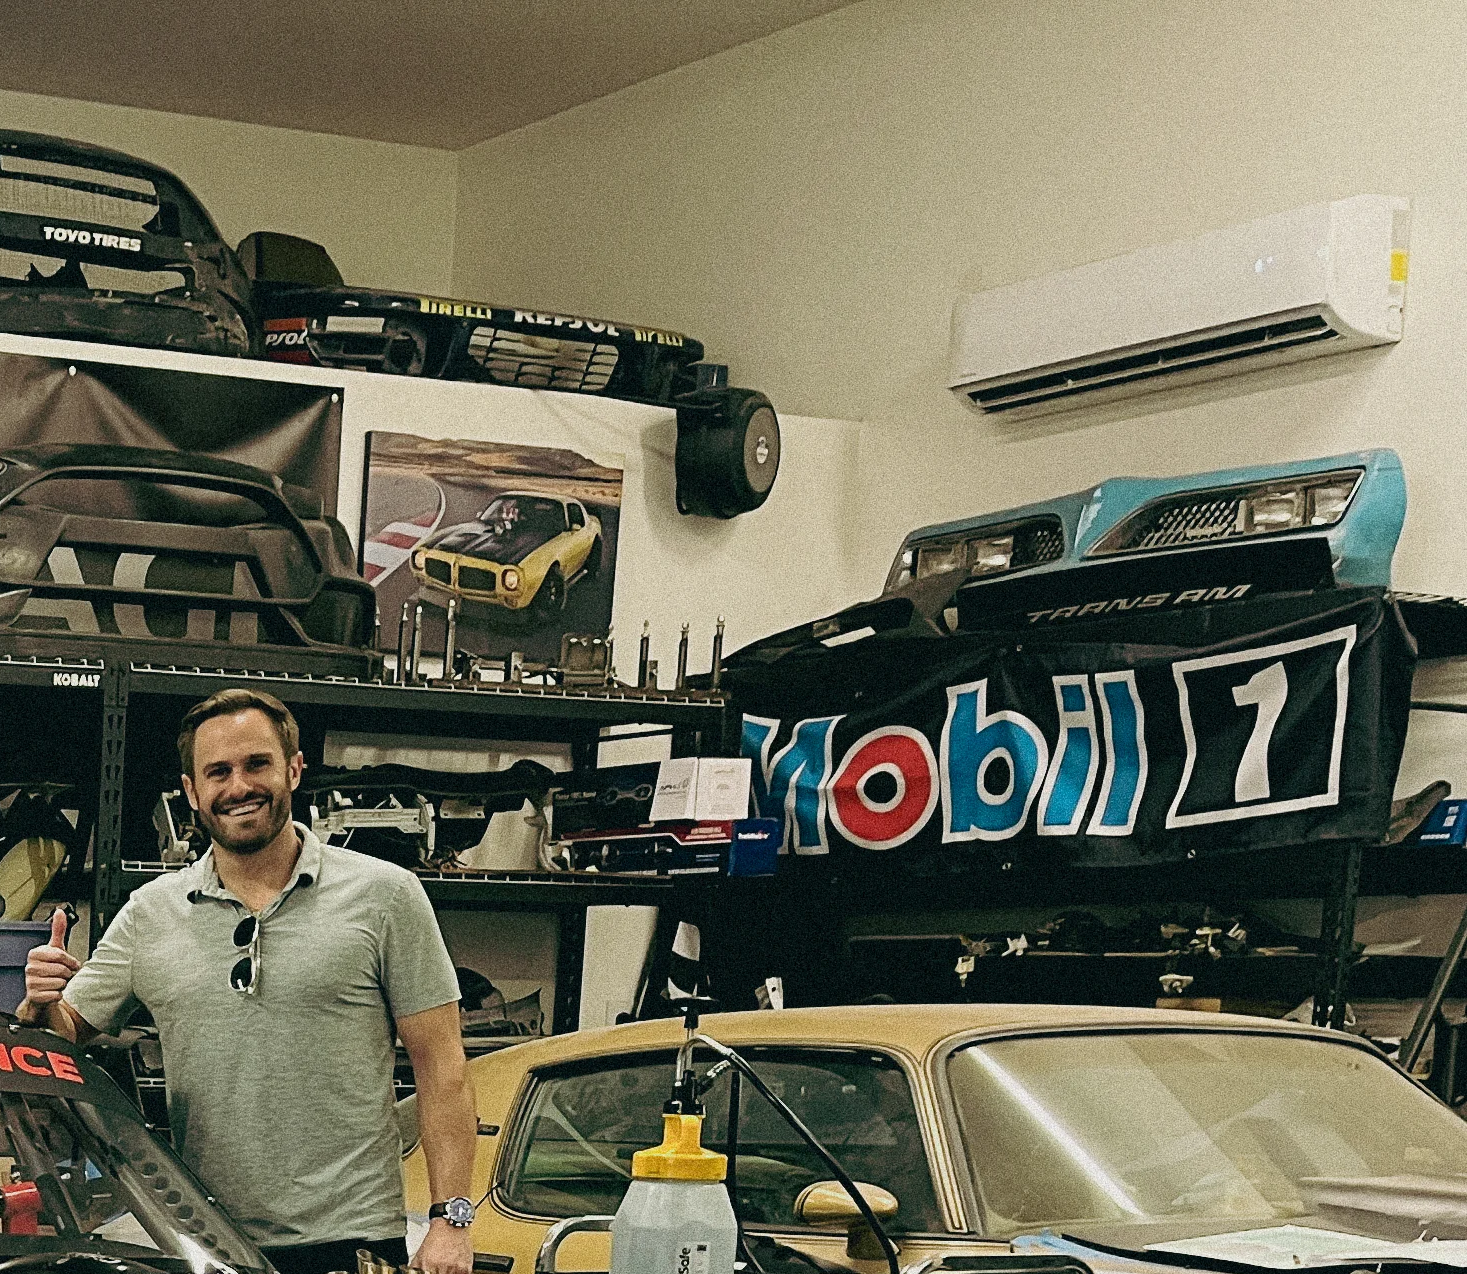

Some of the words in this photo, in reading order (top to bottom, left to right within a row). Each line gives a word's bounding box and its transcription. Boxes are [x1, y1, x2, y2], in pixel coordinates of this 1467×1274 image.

[43, 226, 91, 246] TOYO
[93, 230, 142, 252] TIRES
[420, 299, 492, 320] PIRELLI
[1027, 594, 1164, 624] TRANS
[1173, 583, 1253, 606] AM
[53, 672, 101, 688] KOBALT
[741, 670, 1148, 856] Mobil
